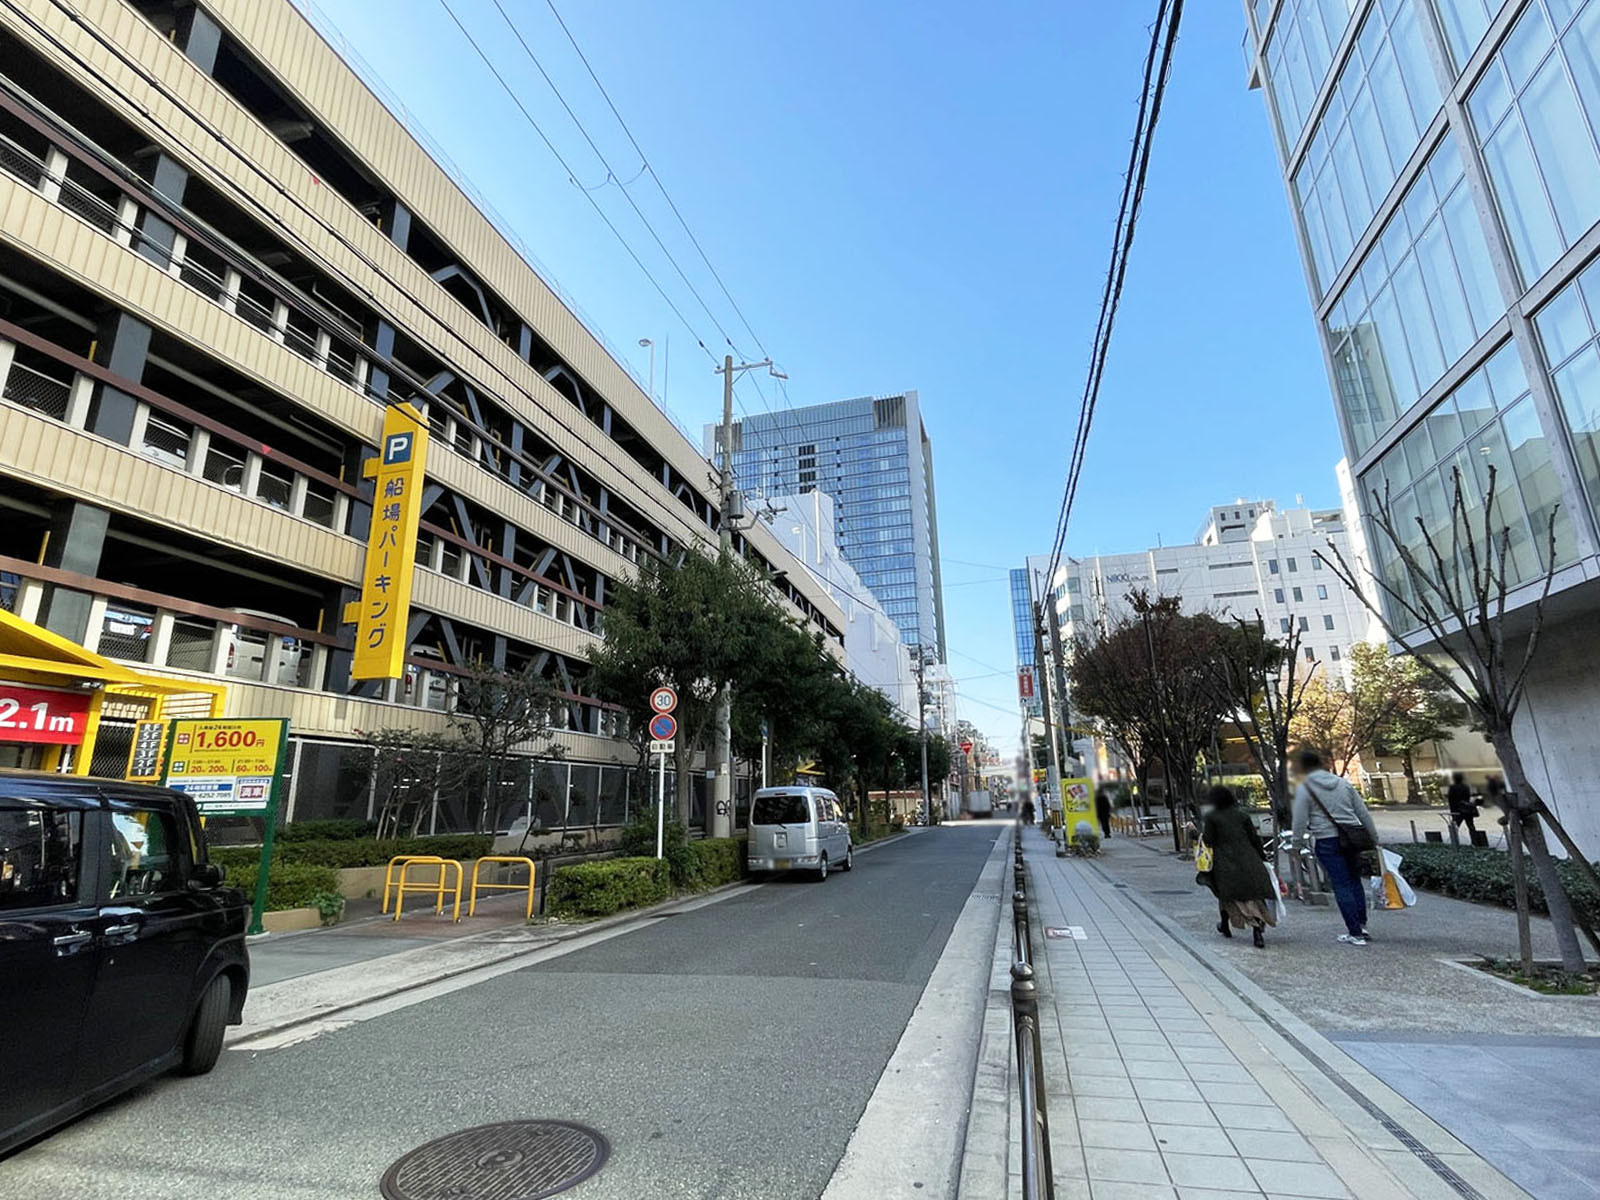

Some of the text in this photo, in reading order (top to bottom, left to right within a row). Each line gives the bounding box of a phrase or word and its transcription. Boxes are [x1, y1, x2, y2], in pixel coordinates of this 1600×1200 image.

[387, 436, 408, 461] P
[368, 477, 405, 649] 船場パーキング
[0, 697, 74, 733] 2.1m
[656, 694, 672, 707] 30
